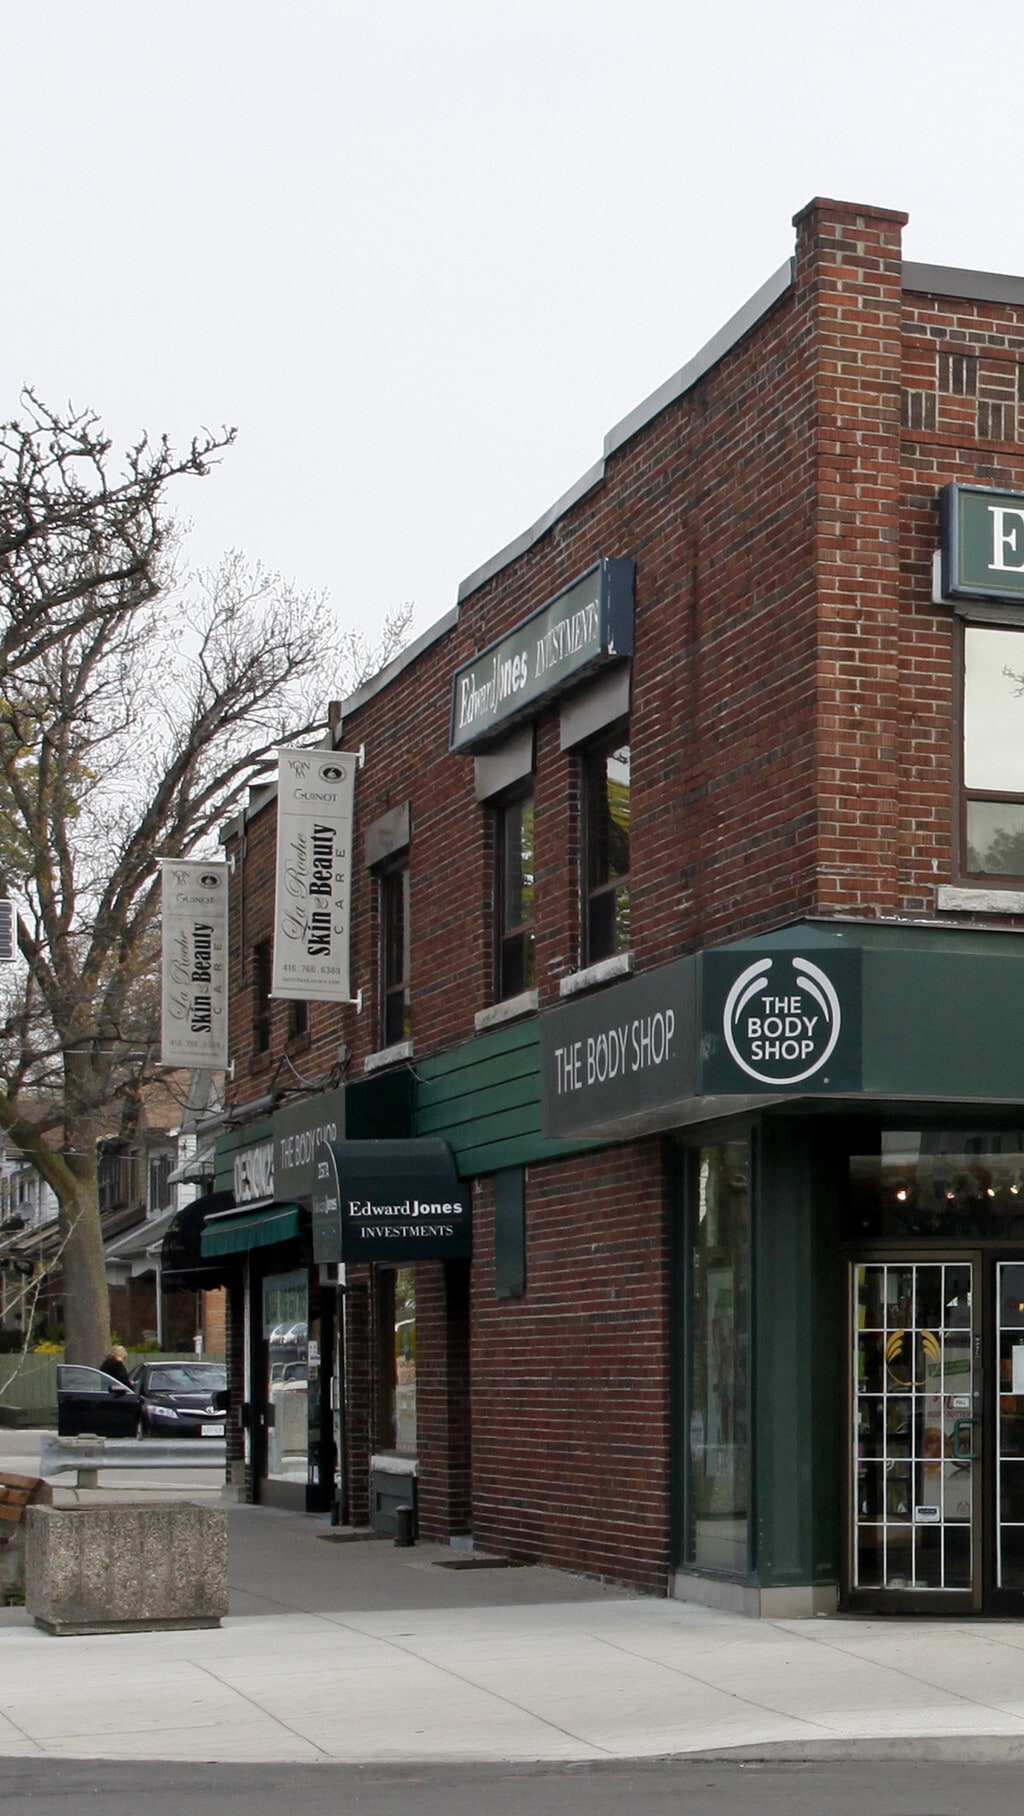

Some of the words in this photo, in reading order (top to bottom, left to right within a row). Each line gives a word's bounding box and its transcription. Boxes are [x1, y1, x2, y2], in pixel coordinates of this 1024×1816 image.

[309, 823, 337, 897] Beauty
[335, 848, 346, 935] CARE
[192, 922, 214, 983] Beauty
[307, 911, 332, 957] Skin
[191, 996, 212, 1033] Skin
[761, 996, 803, 1015] THE
[747, 1016, 819, 1038] BODY
[554, 1042, 582, 1094] THE
[587, 1025, 629, 1085] BODY
[632, 1009, 675, 1071] SHOP
[750, 1041, 815, 1061] SHOP
[361, 1225, 454, 1239] INVESTMENTS
